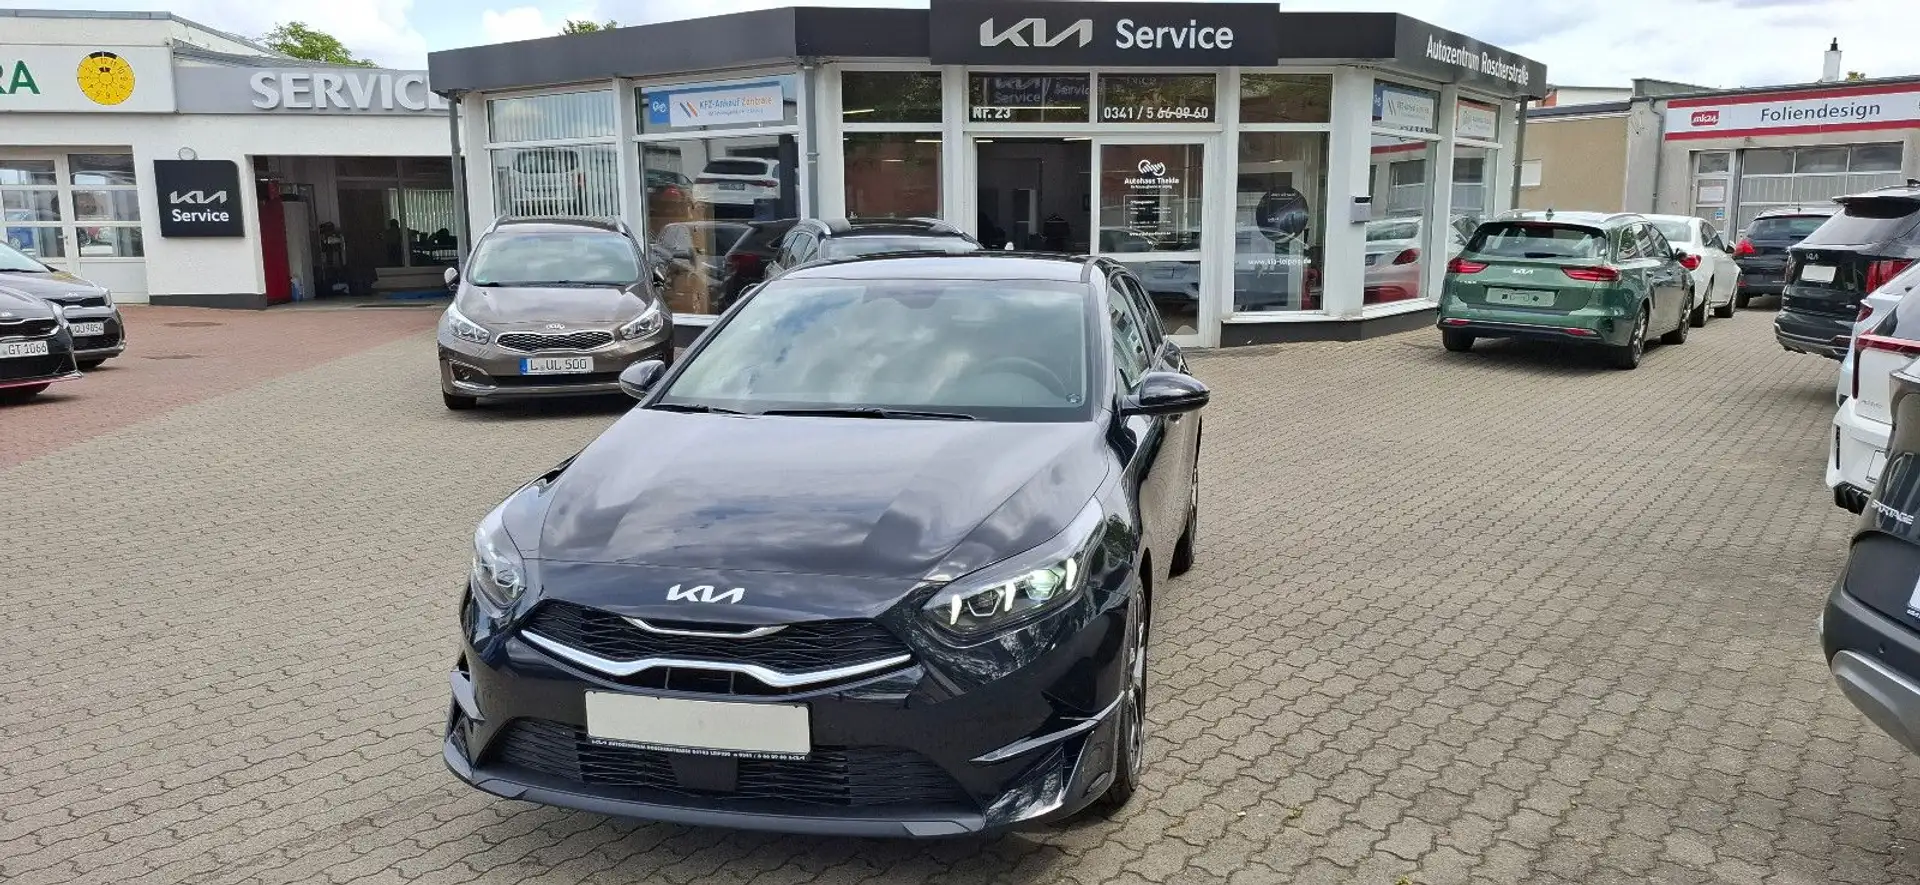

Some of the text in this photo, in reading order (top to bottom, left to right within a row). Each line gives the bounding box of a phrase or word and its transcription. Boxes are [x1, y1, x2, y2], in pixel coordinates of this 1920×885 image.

[980, 18, 1233, 49] KIA Service
[1426, 33, 1529, 86] Autozentrum Roscherstraße
[0, 60, 40, 94] A
[973, 106, 1011, 119] Nr. 23
[1104, 106, 1208, 120] 0341 / 5 66 09 60
[1760, 102, 1880, 121] Foliendesign
[170, 190, 227, 204] KIA
[172, 208, 229, 222] Service
[8, 344, 22, 356] GT
[530, 358, 587, 371] L UL 500
[666, 583, 745, 604] KIA
